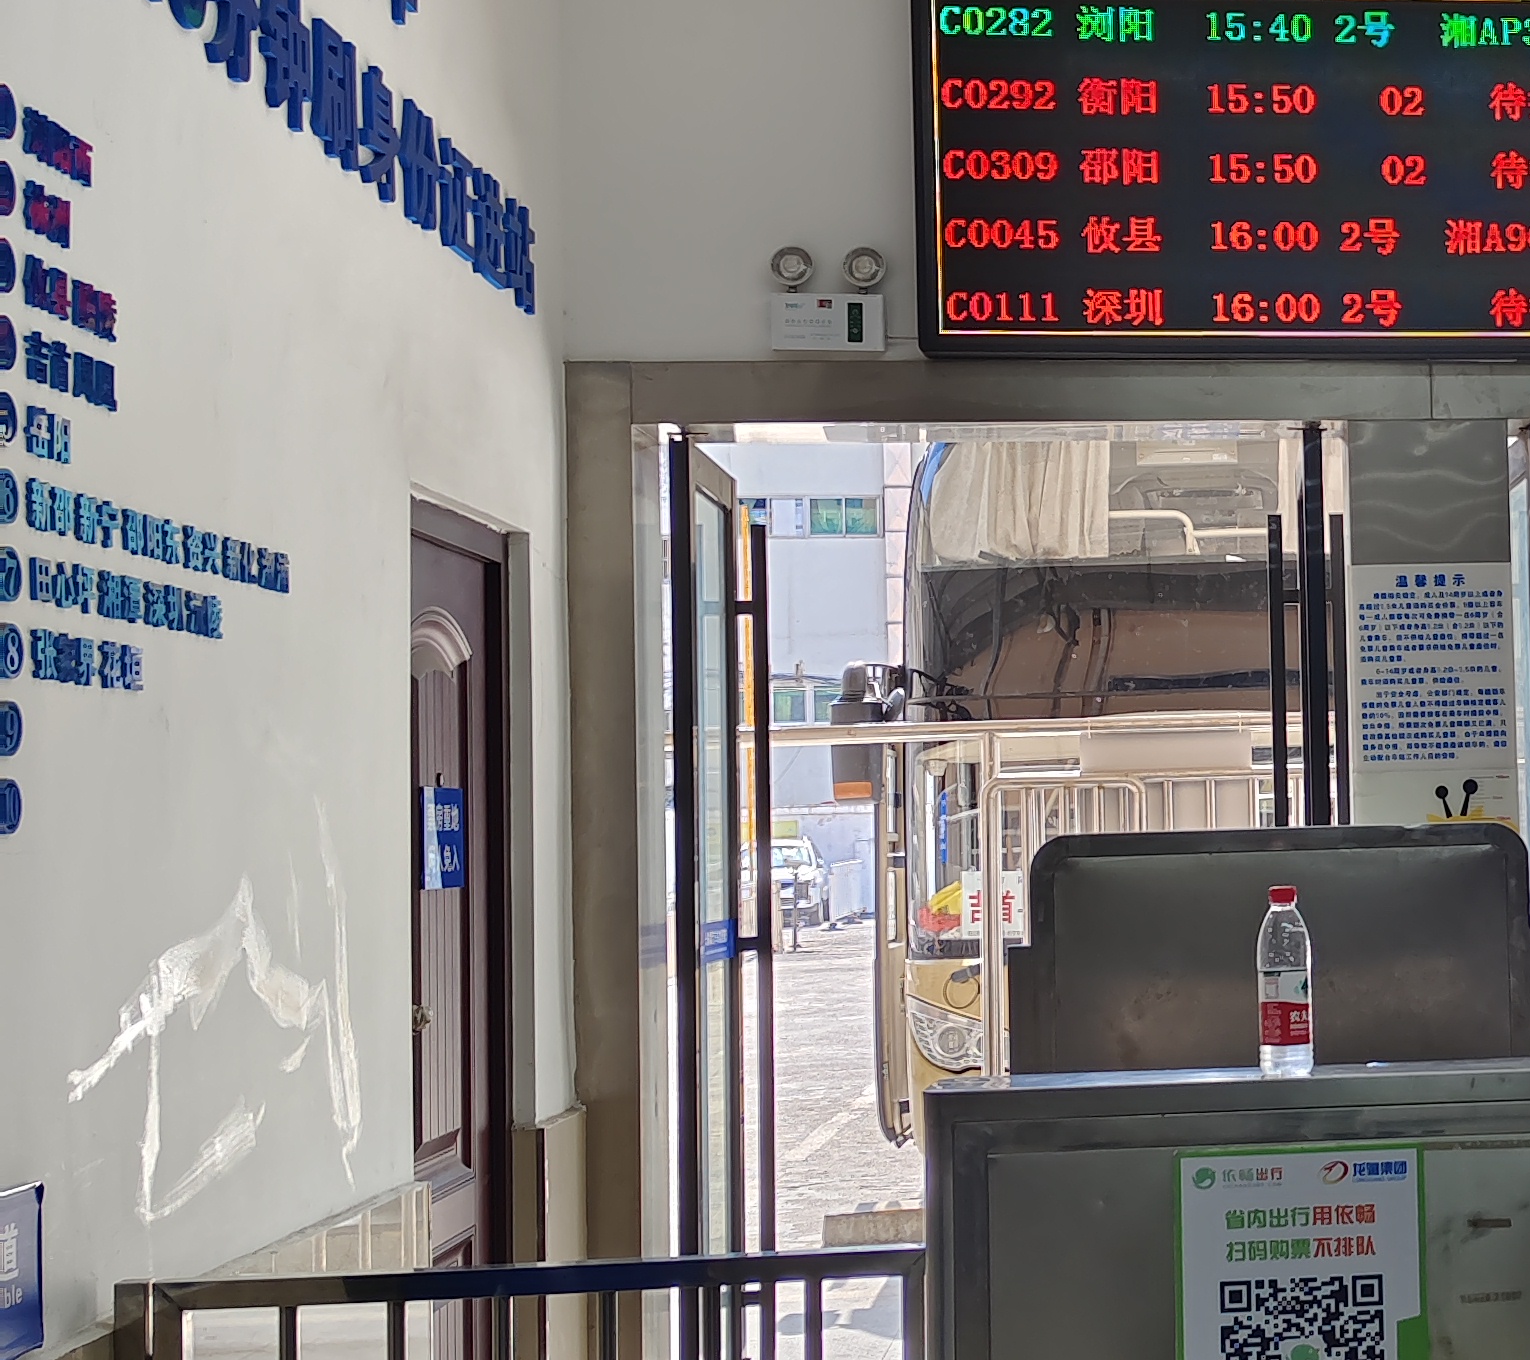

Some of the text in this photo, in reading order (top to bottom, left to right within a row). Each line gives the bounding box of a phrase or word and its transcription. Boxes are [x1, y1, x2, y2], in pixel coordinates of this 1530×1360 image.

[940, 6, 1052, 36] C0282
[1076, 6, 1154, 42] 浏阳
[1207, 13, 1311, 42] 15:40
[1335, 12, 1395, 47] 2号
[941, 79, 1056, 109] C0292
[1078, 78, 1158, 115] 衡阳
[1208, 84, 1316, 113] 15:50
[1380, 86, 1425, 115] 02
[943, 150, 1059, 180] C0309
[1080, 148, 1160, 185] 邵阳
[1210, 154, 1318, 183] 15:50
[1382, 156, 1426, 185] 02
[945, 219, 1060, 249] C0045
[1211, 221, 1319, 251] 16:00
[1340, 218, 1400, 255] 2号
[947, 292, 1059, 321] C0111
[1083, 289, 1164, 325] 深圳
[1213, 292, 1320, 323] 16:00
[1342, 290, 1402, 327] 2号
[1395, 573, 1466, 588] 温馨提示
[1224, 1203, 1377, 1230] 省内出行用依畅
[1226, 1235, 1377, 1263] 扫码购票不排队
